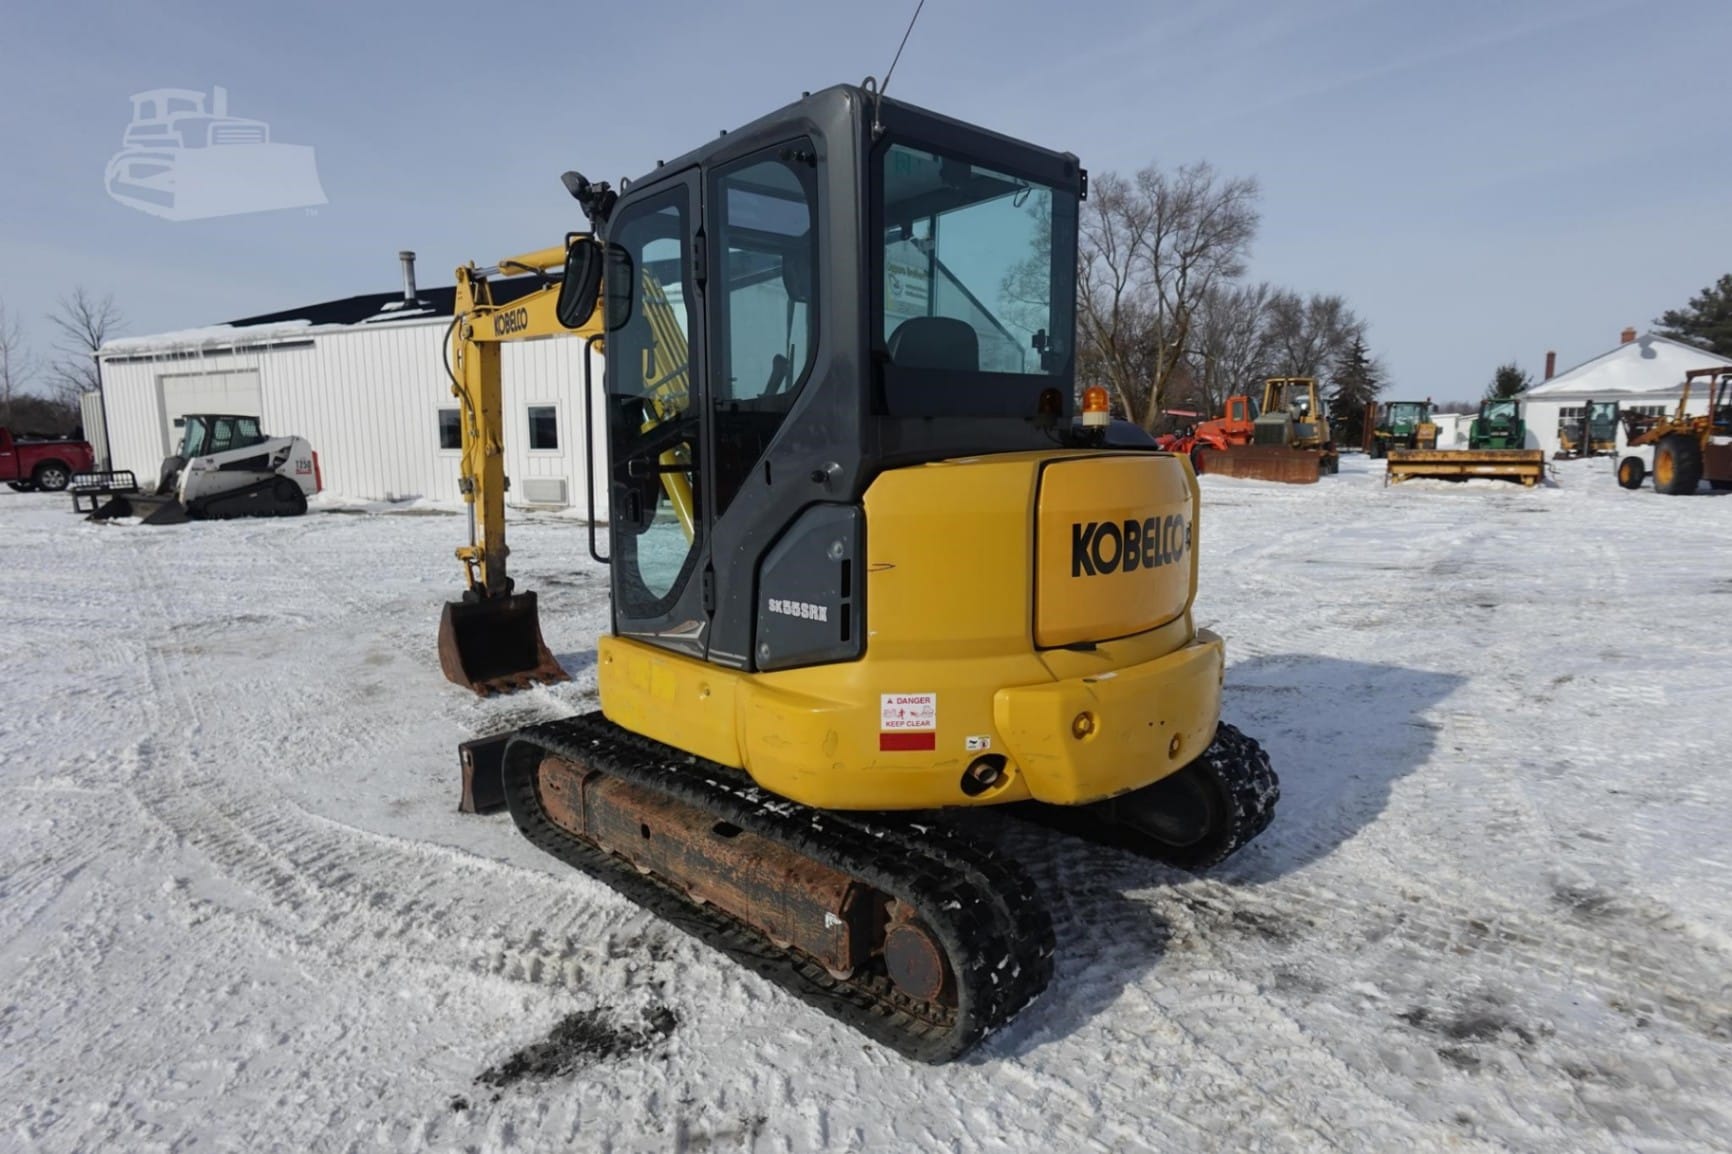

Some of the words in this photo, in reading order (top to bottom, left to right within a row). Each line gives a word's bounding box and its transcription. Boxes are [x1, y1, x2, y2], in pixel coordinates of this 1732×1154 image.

[494, 307, 528, 337] KOBELCO
[1072, 513, 1185, 578] KOBELCO
[896, 696, 931, 705] DANGER
[885, 720, 905, 728] KEEP
[906, 719, 931, 727] CLEAR
